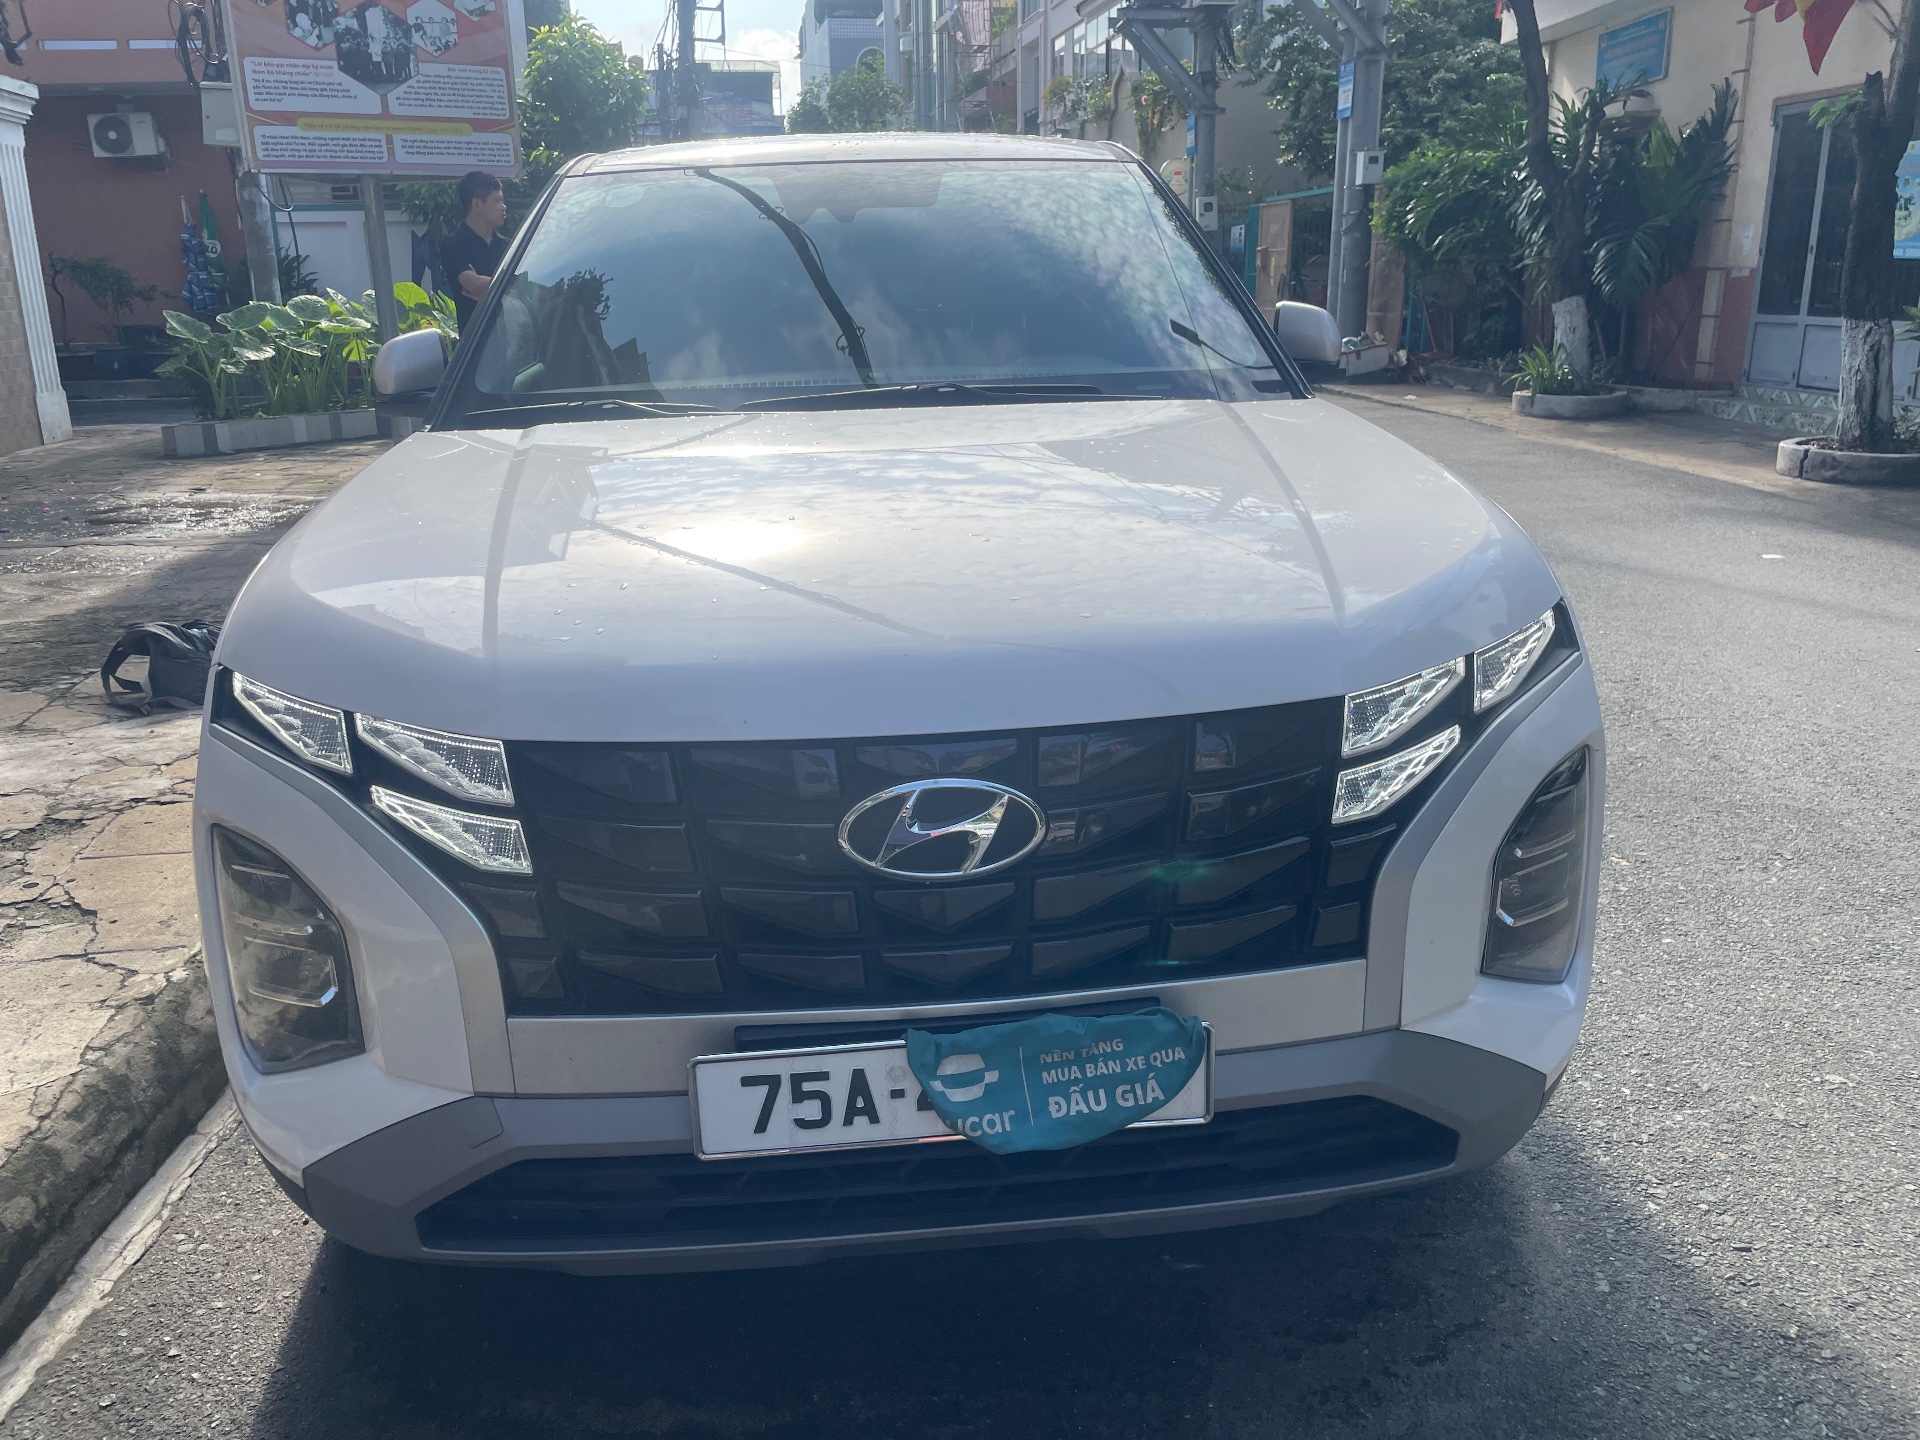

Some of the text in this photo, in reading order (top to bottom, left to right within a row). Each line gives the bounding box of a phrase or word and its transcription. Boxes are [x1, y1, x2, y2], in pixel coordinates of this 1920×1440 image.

[1041, 1046, 1186, 1085] MUA BÁN XE QUA
[1048, 1073, 1165, 1119] ĐẤU GIÁ
